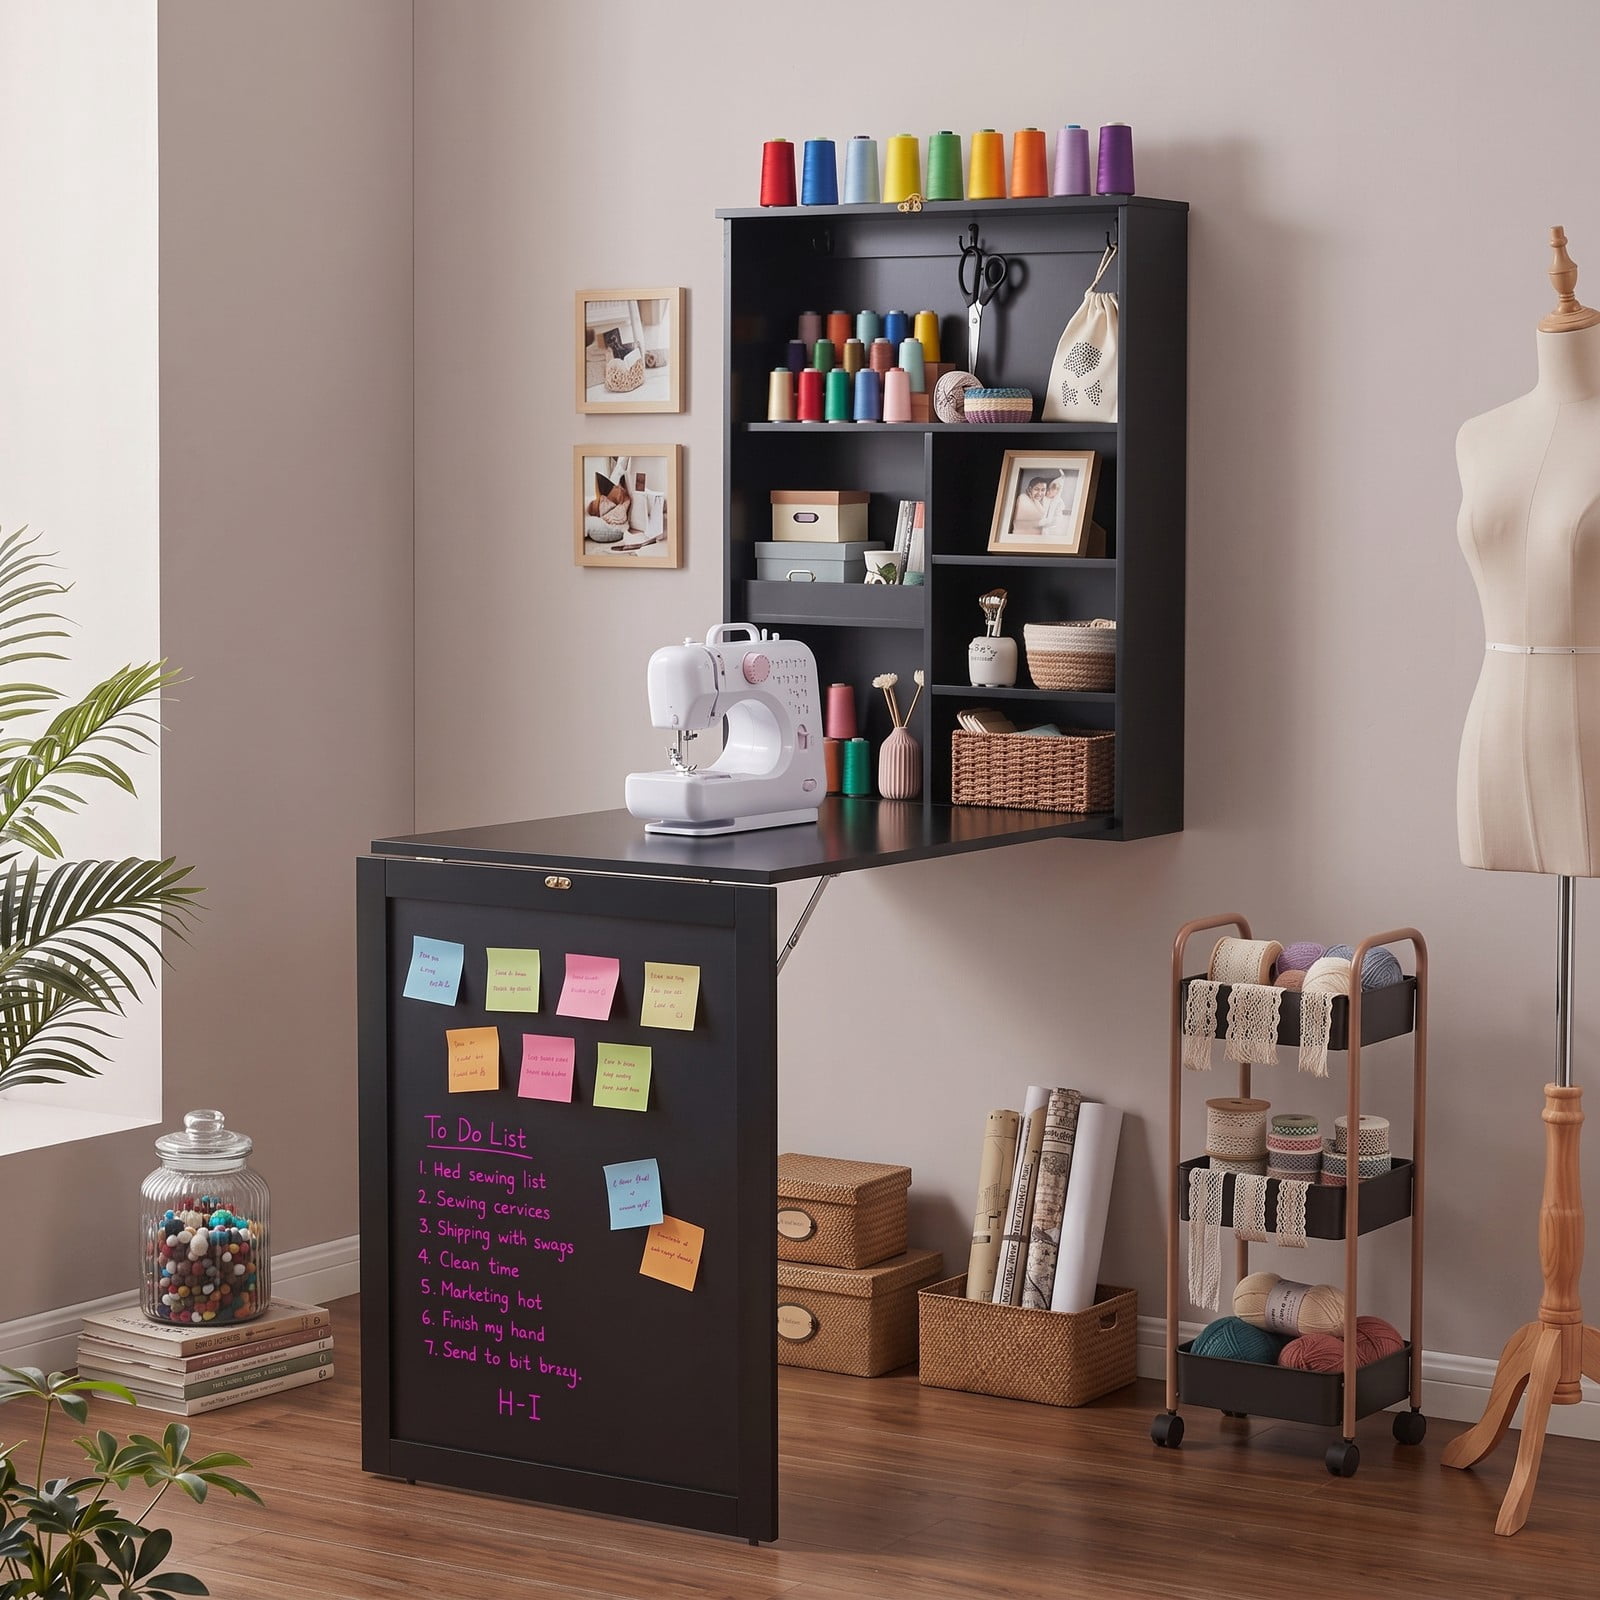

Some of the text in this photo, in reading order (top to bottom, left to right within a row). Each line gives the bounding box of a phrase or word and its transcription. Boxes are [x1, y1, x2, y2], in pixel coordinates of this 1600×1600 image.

[423, 1114, 528, 1150] To Do List
[418, 1160, 548, 1196] 1. Hed sewing list
[417, 1188, 552, 1221] 2. Sewing cervices
[419, 1217, 575, 1264] 3. Shipping with swaps
[417, 1248, 520, 1279] 4. Clean time
[420, 1277, 544, 1315] 5. Marketing hot
[421, 1308, 546, 1343] 6. Finish my hand
[423, 1338, 439, 1357] 7.
[442, 1340, 478, 1362] Send
[483, 1347, 502, 1366] to
[508, 1351, 533, 1372] bit
